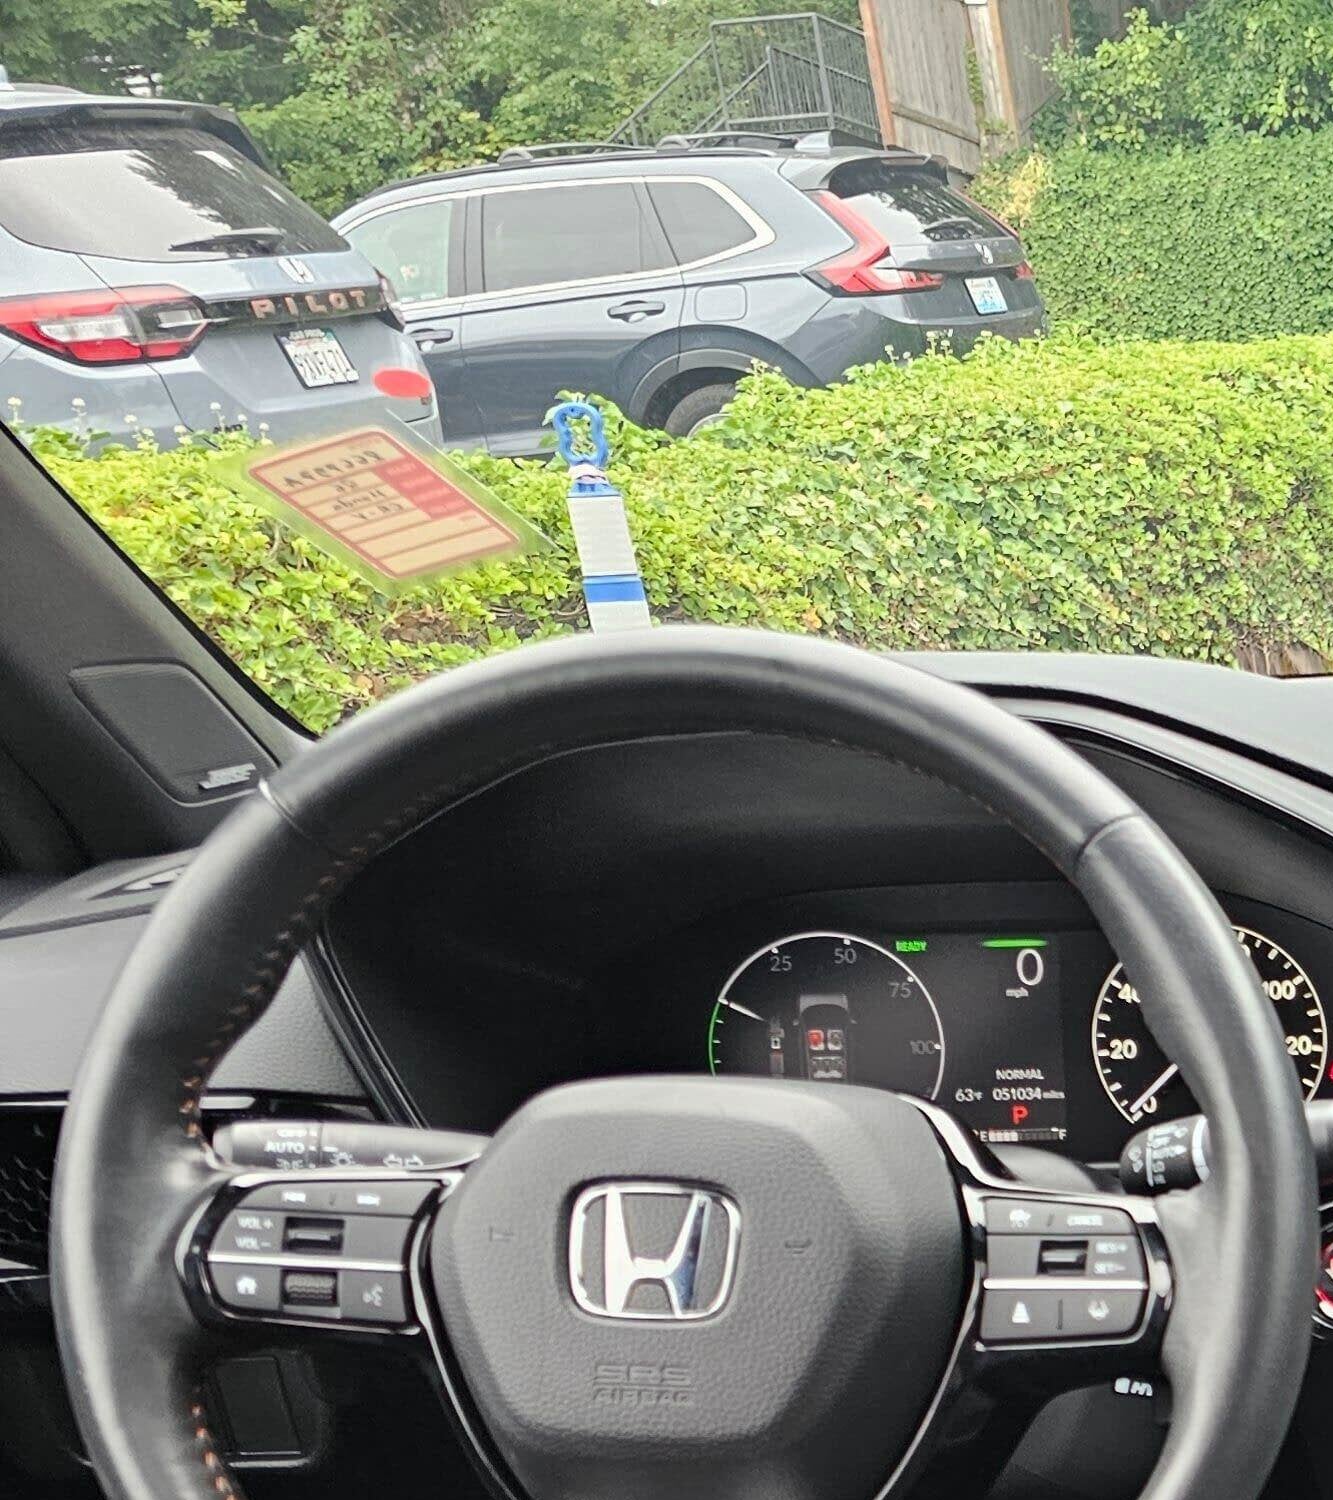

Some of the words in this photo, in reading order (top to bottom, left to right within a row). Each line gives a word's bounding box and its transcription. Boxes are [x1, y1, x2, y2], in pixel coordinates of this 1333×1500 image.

[251, 290, 367, 319] PILOT
[896, 940, 927, 952] READY
[770, 956, 793, 971] 25
[834, 949, 857, 964] 50
[1016, 951, 1044, 986] 0
[889, 982, 911, 998] 75
[1262, 981, 1296, 999] 100
[910, 1040, 935, 1055] 100
[1109, 1039, 1138, 1060] 20
[1285, 1035, 1312, 1055] 20
[995, 1069, 1045, 1080] NORMAL
[992, 1087, 1041, 1100] 051034
[1012, 1104, 1029, 1125] P
[980, 1131, 988, 1142] E
[1059, 1128, 1067, 1140] F
[263, 1141, 305, 1154] AUTO
[592, 1362, 691, 1384] SRS
[592, 1385, 694, 1403] AIRBAG
